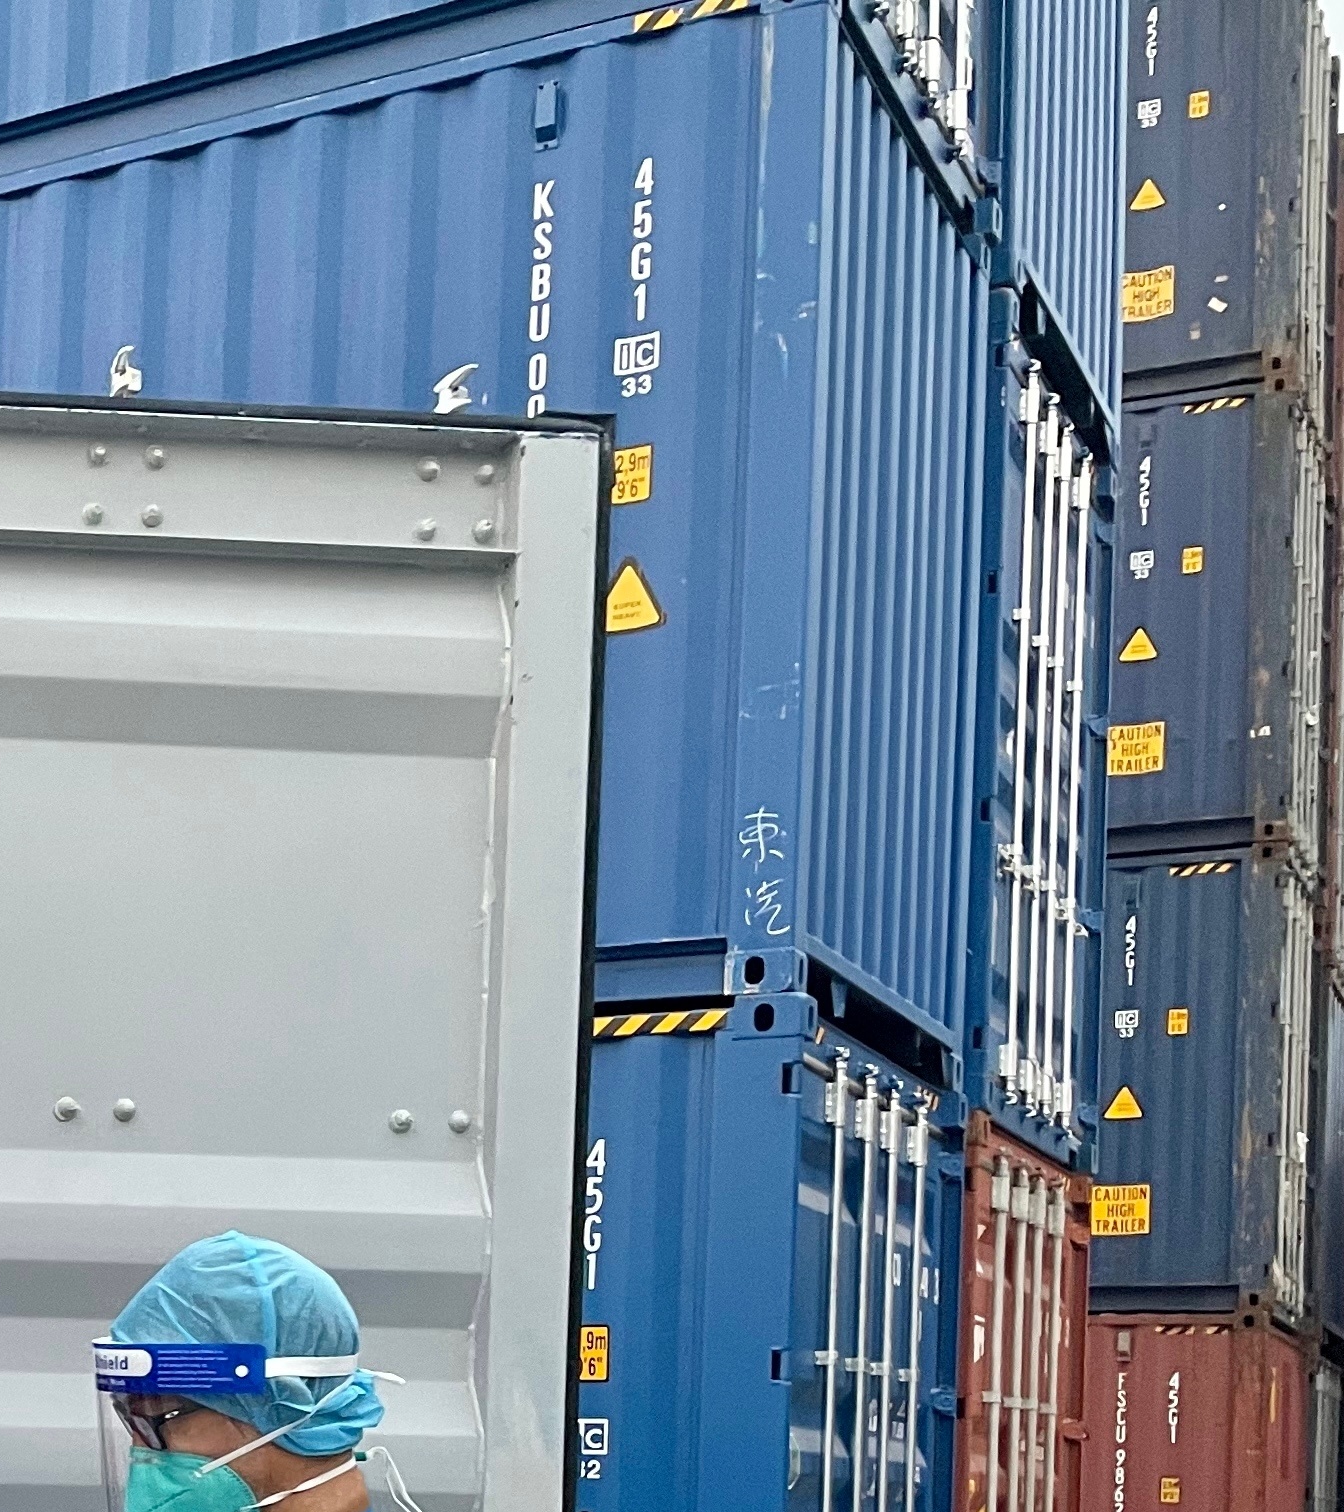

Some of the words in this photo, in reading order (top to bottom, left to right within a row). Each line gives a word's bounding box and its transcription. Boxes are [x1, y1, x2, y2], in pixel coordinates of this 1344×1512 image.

[629, 157, 654, 322] 45G1
[530, 180, 555, 342] KSBU
[1132, 287, 1160, 302] HIGH
[621, 375, 652, 398] 33
[1138, 456, 1151, 526] 45G1
[1110, 724, 1161, 741] CAUTION
[1121, 741, 1149, 756] HIGH
[1110, 757, 1159, 773] TRAILER
[1125, 915, 1136, 986] 45G1
[1095, 1187, 1147, 1201] CAUTION
[584, 1138, 606, 1290] 45G1
[1107, 1202, 1135, 1217] HIGH
[1095, 1218, 1146, 1233] TRAILER
[1115, 1372, 1127, 1443] FSCU
[1169, 1371, 1179, 1444] 45G1
